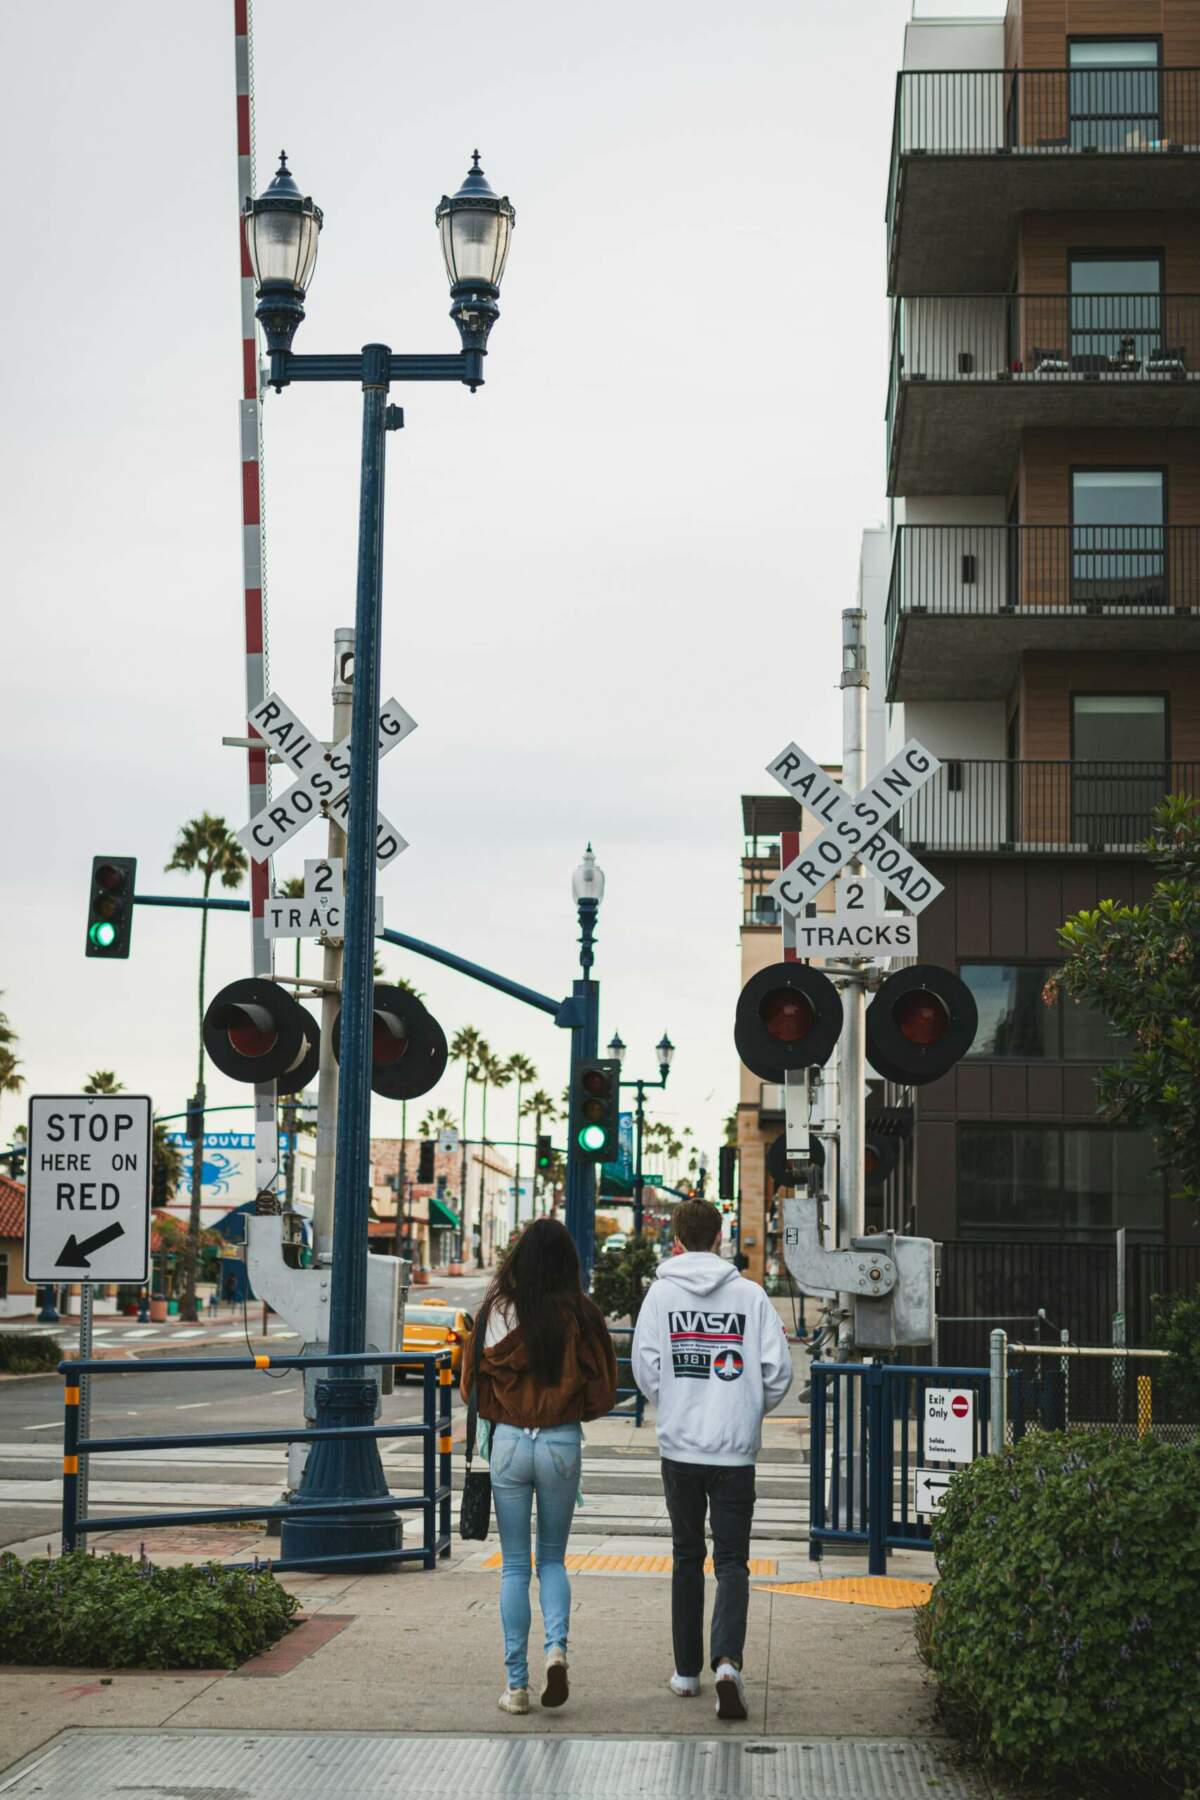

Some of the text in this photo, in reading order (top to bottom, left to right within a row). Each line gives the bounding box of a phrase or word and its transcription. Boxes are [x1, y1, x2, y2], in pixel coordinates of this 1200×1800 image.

[255, 702, 312, 768] RAIL
[252, 714, 401, 847] CROSSG
[775, 751, 841, 823] RAIL
[779, 750, 930, 905] CROSSING
[315, 866, 333, 892] 2
[859, 833, 932, 903] ROAD
[846, 884, 864, 909] 2
[802, 925, 911, 946] TRACKS
[46, 1113, 134, 1142] STOP
[41, 1154, 137, 1171] HERE ON
[56, 1183, 120, 1211] RED
[671, 1312, 741, 1334] NASA
[677, 1354, 706, 1365] 1981
[928, 1394, 945, 1405] Exit
[928, 1407, 948, 1421] Only
